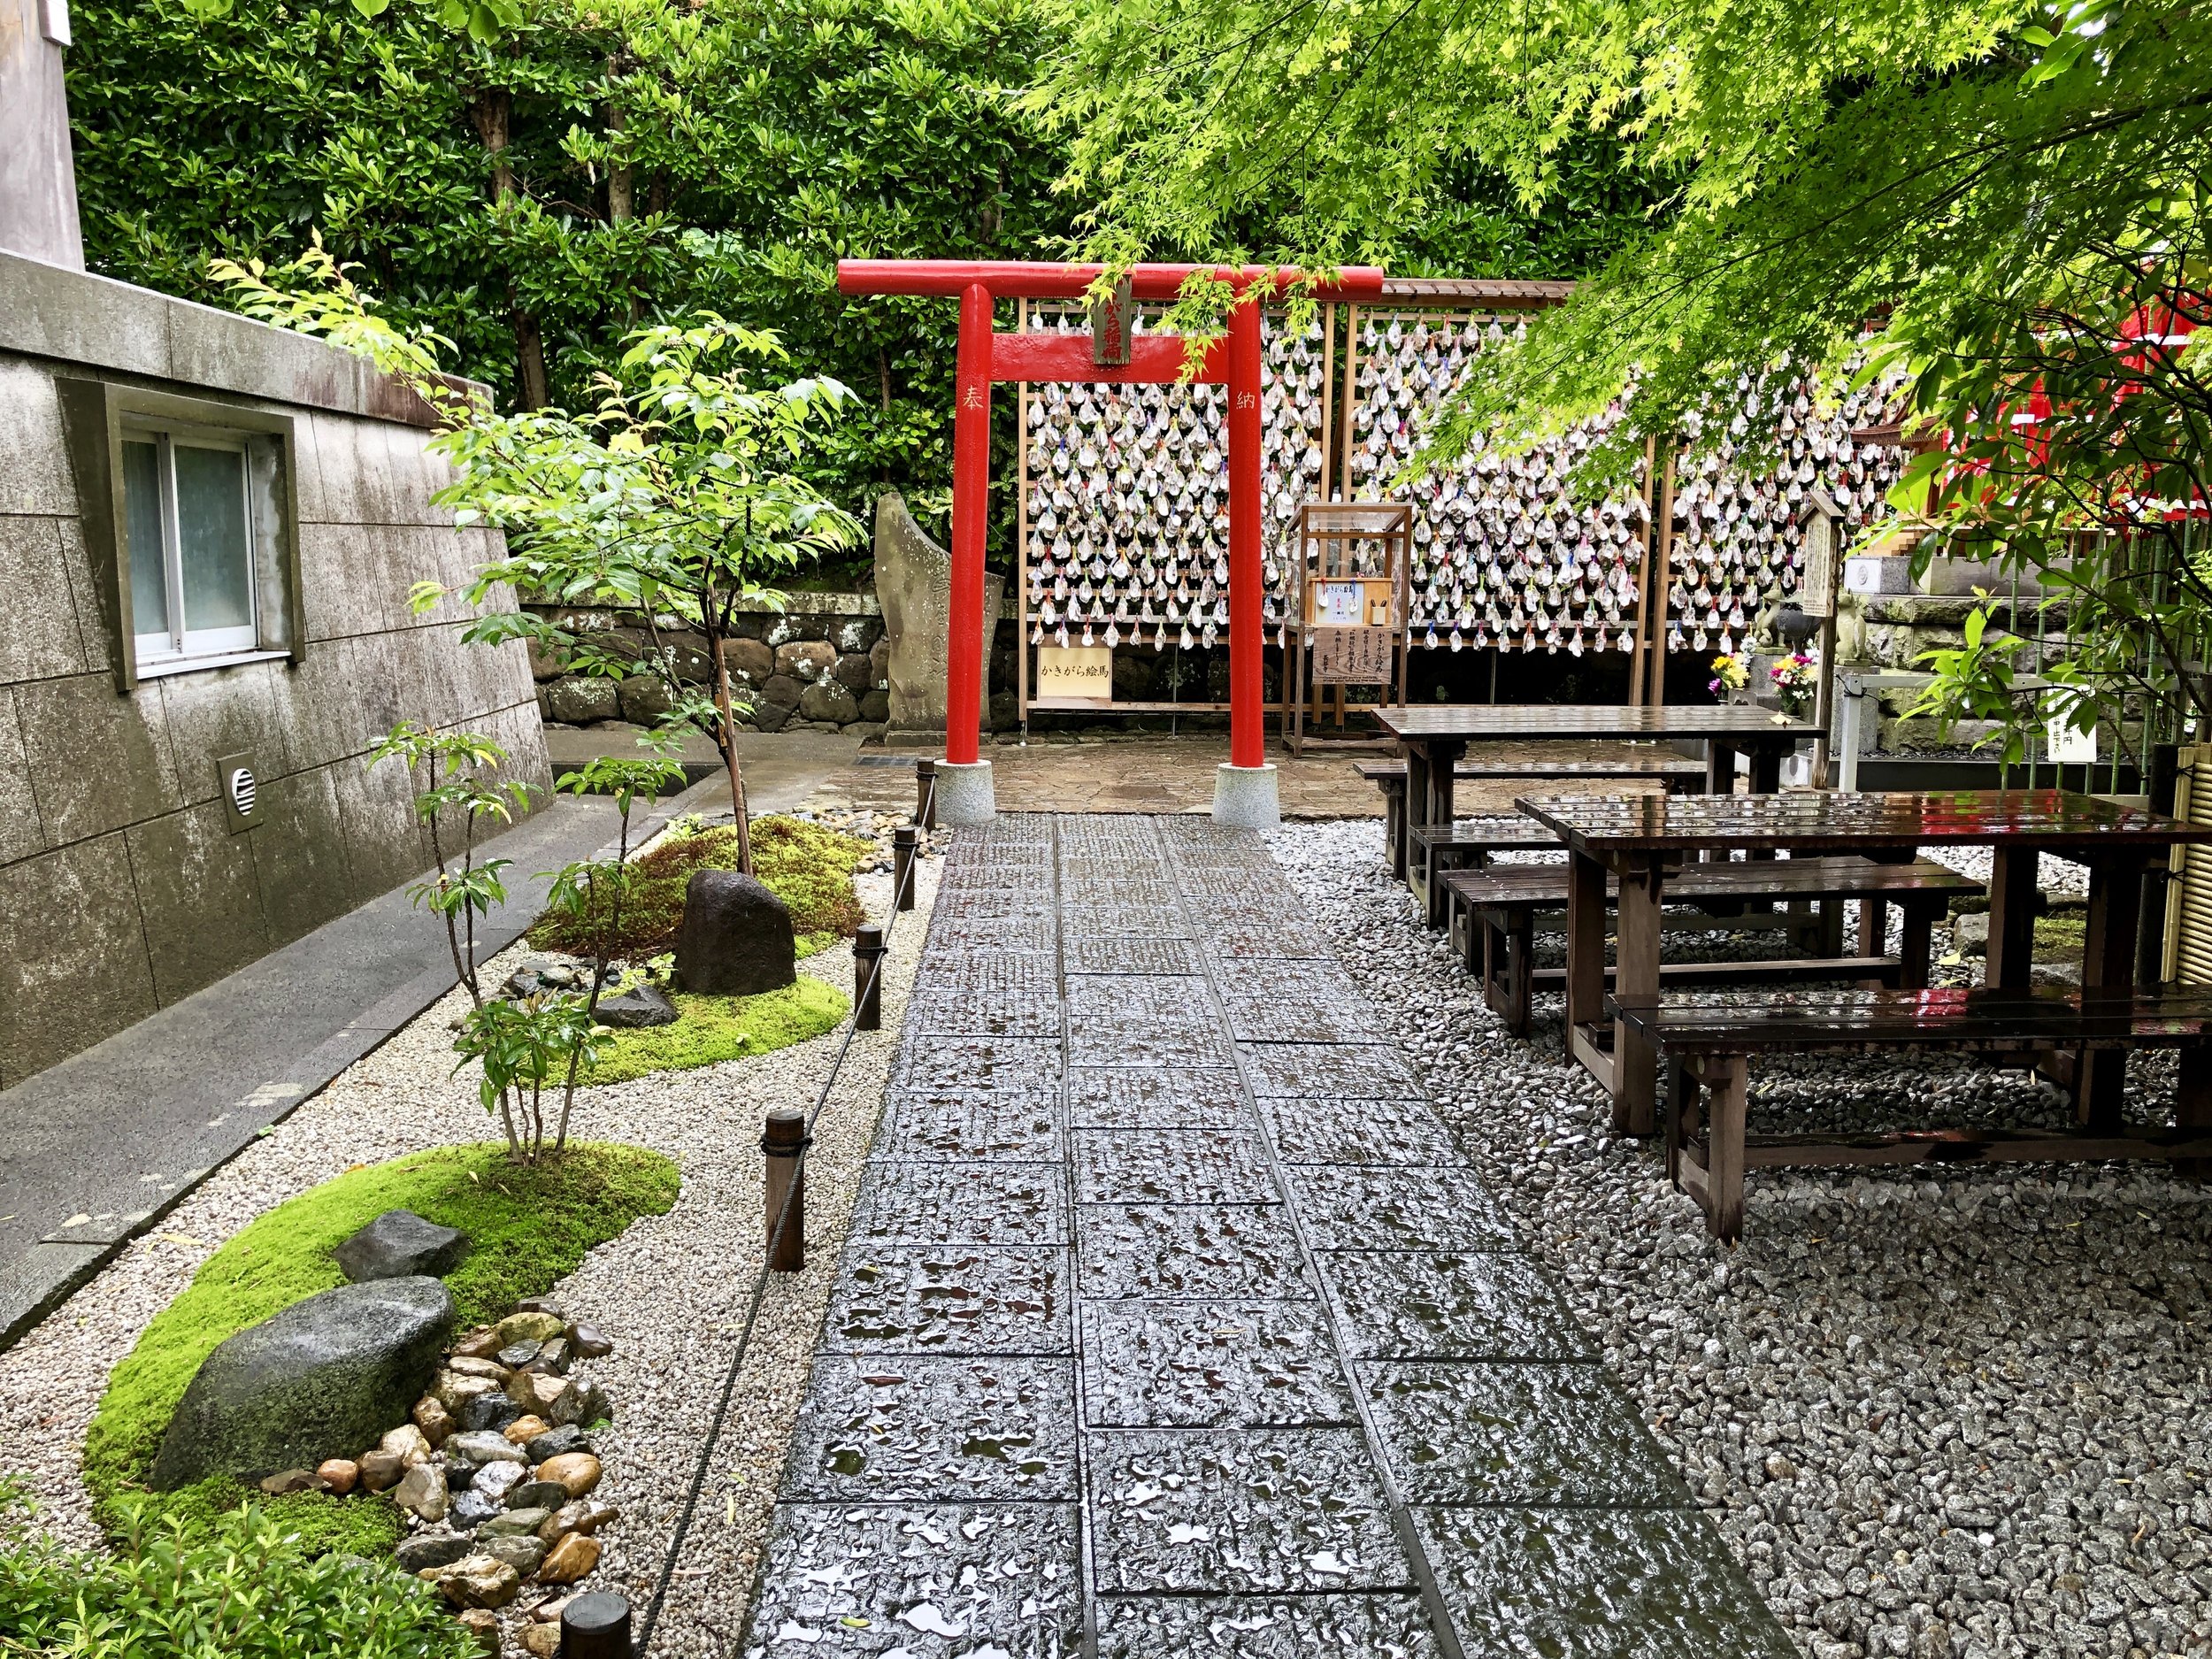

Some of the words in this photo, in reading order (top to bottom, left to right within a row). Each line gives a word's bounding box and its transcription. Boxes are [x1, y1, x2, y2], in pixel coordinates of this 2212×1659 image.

[1102, 292, 1122, 359] がら稲荷
[963, 384, 984, 411] 奉
[1236, 390, 1256, 410] 納
[1375, 633, 1386, 673] かきがら絵馬
[1041, 664, 1110, 679] かきがら絵馬
